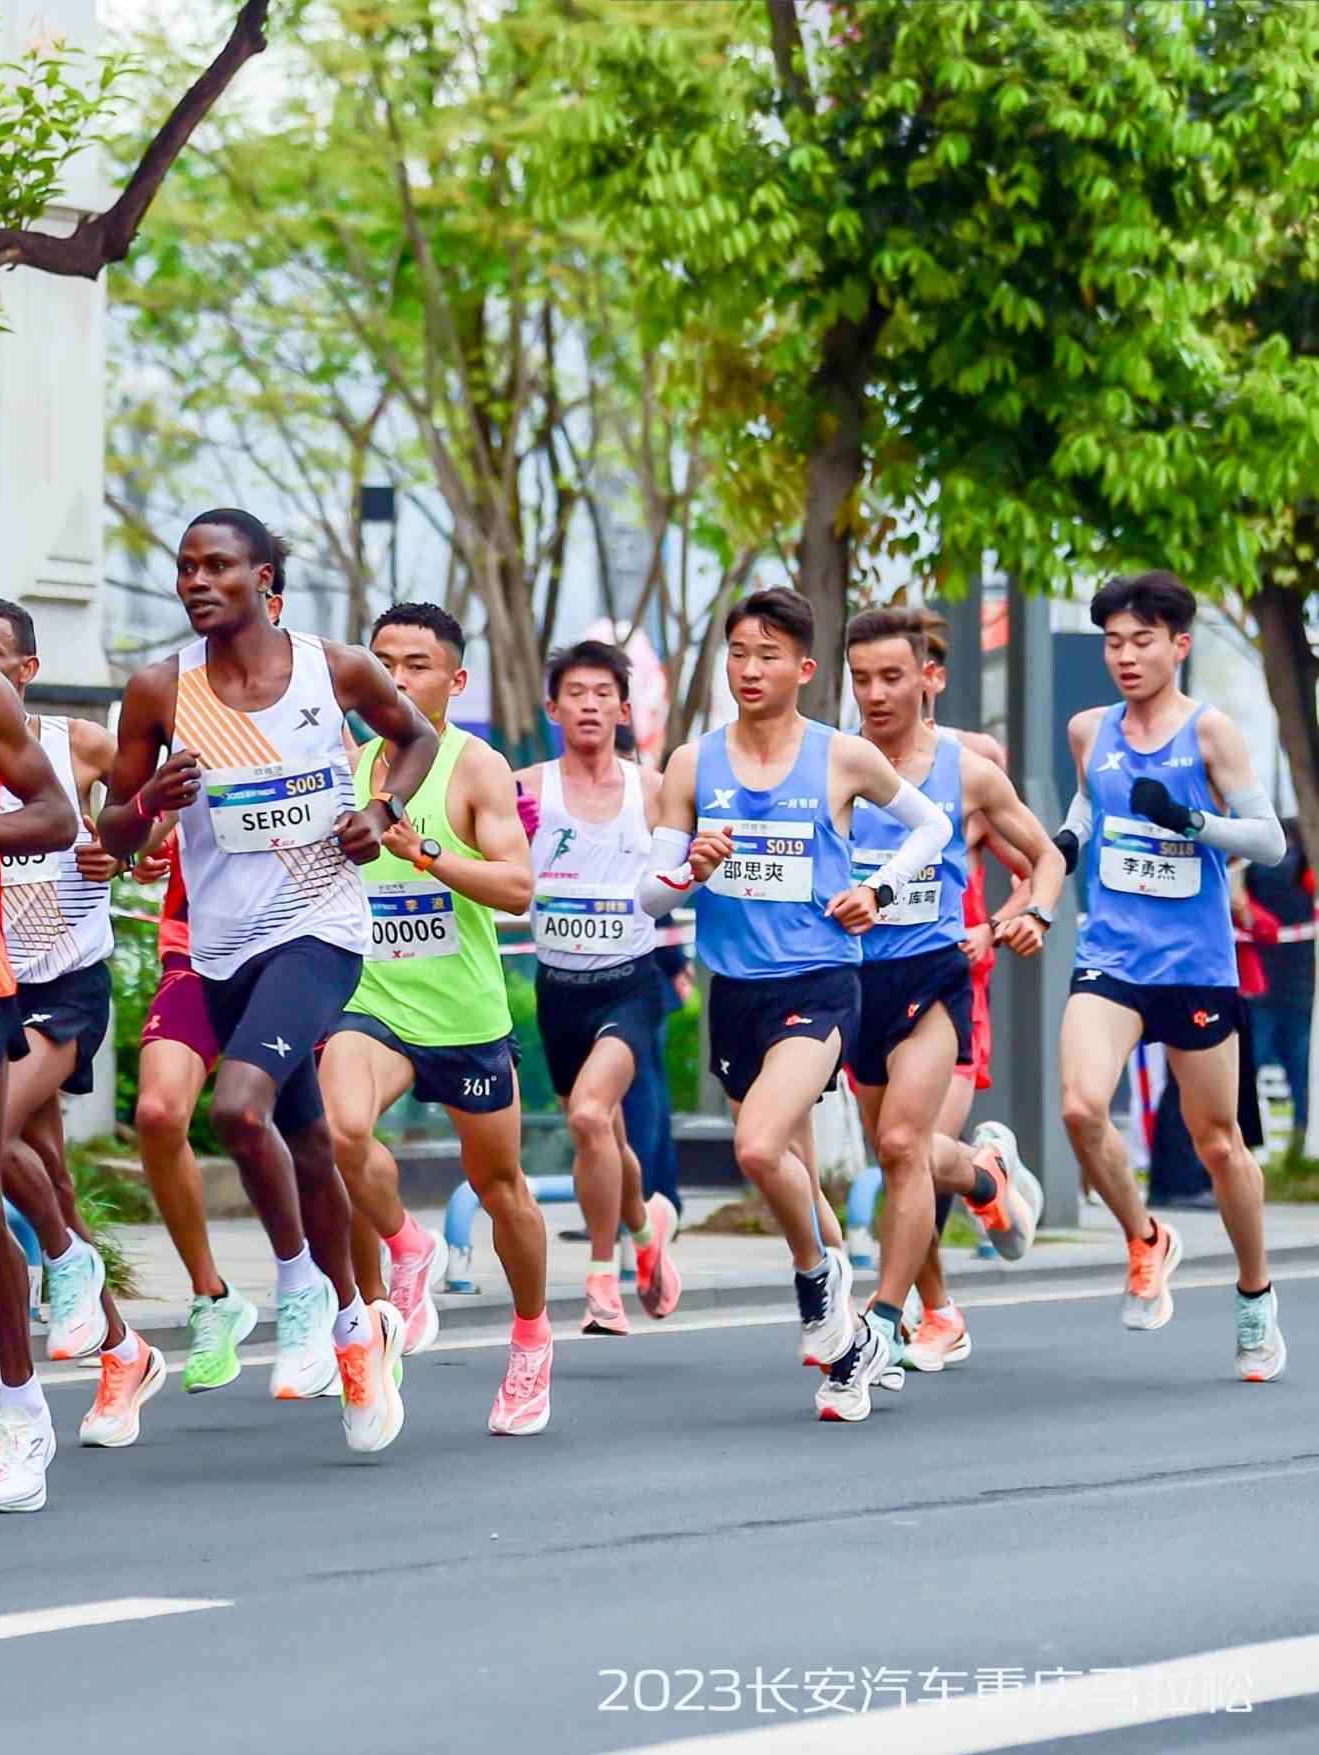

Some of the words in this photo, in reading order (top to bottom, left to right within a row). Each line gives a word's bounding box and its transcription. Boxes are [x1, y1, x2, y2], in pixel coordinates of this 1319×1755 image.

[285, 773, 325, 796] S003
[242, 804, 311, 831] SEROI
[766, 839, 804, 855] S019
[723, 860, 784, 882] 邵思爽
[1122, 857, 1176, 881] 李勇杰
[372, 917, 446, 945] 00006
[544, 917, 624, 939] A00019
